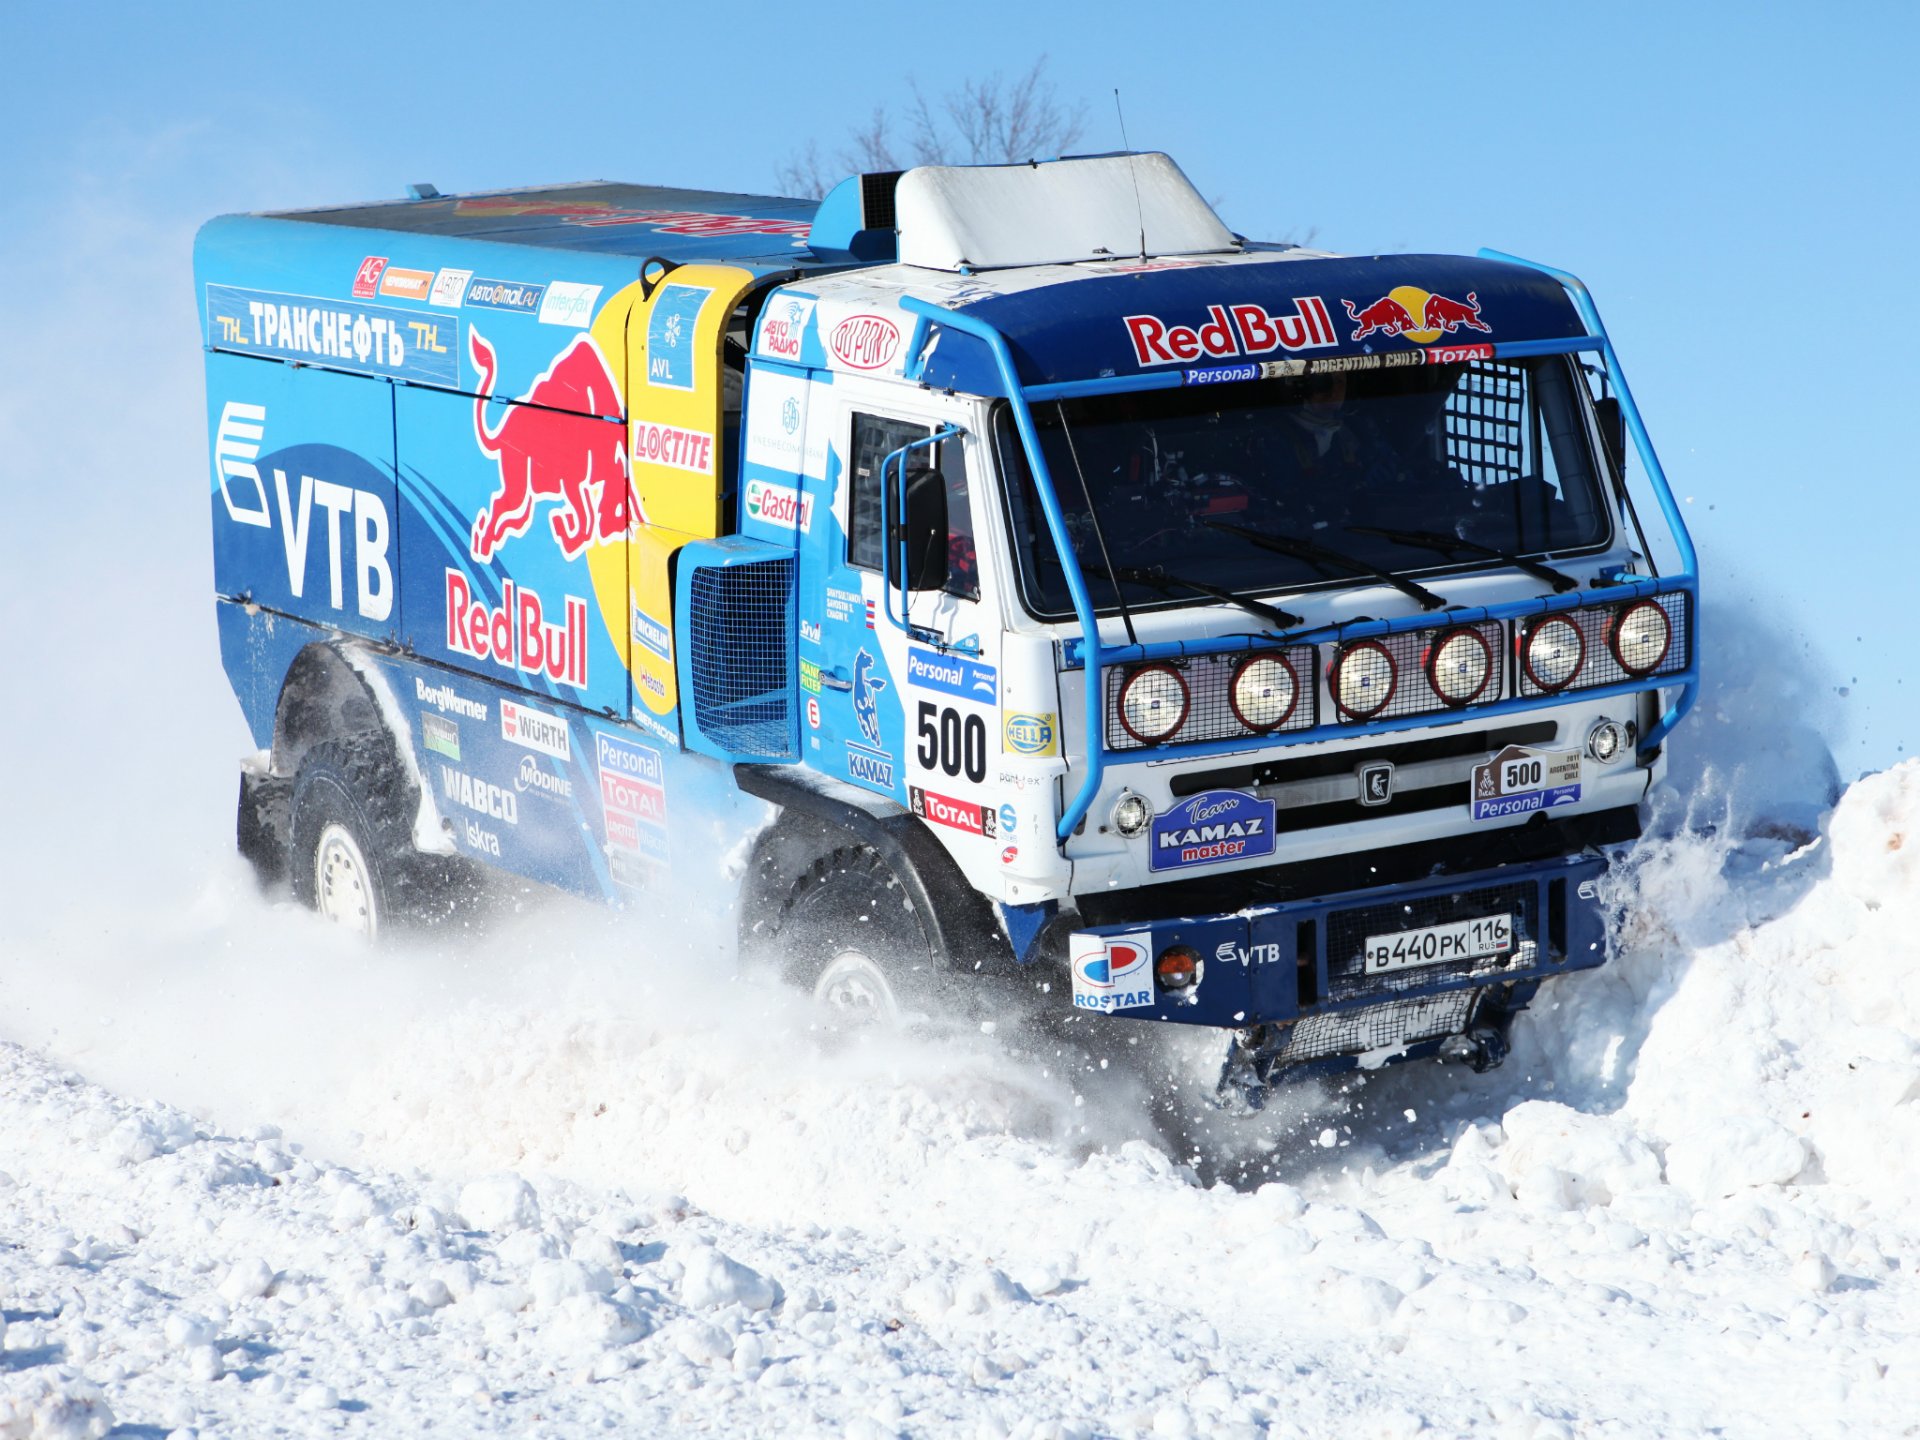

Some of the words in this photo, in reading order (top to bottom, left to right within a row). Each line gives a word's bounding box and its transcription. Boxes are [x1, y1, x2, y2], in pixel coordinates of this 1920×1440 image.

[357, 259, 384, 284] AG
[249, 301, 405, 367] ТРАНСНЕФТЬ
[768, 337, 799, 356] РАДИО
[1123, 304, 1241, 367] Red
[1230, 296, 1339, 355] Bull
[651, 358, 673, 380] AVL
[1188, 364, 1256, 384] Personal
[1310, 356, 1380, 374] ARGENTINA
[1385, 352, 1419, 367] CHILE
[1430, 349, 1491, 363] TOTAL
[636, 424, 711, 470] LOCTITE
[761, 488, 810, 527] Castrol
[273, 468, 395, 623] VTB
[446, 566, 516, 669] Red
[516, 588, 588, 690] Bull
[637, 617, 668, 650] MICHELIN
[908, 655, 963, 687] Personal
[972, 669, 996, 683] Personal
[415, 677, 488, 722] BorgWarner
[917, 700, 987, 784] 500
[1008, 725, 1052, 744] HELLA
[601, 738, 658, 779] Personal
[847, 752, 895, 790] KAMAZ
[1549, 763, 1579, 774] ARGENTINA
[1506, 761, 1542, 788] 500
[1564, 772, 1579, 781] CHILE
[441, 764, 519, 825] WABCO
[603, 775, 664, 819] TOTAL
[1479, 791, 1545, 818] Personal
[1553, 786, 1576, 796] Personal
[925, 795, 982, 830] TOTAL
[1185, 796, 1240, 825] Team
[465, 817, 501, 858] Iskra
[1160, 818, 1264, 849] KAMAZ
[1181, 840, 1245, 862] master
[1472, 919, 1505, 943] 116
[1238, 943, 1280, 967] VTB
[1478, 942, 1496, 951] RUS
[1074, 990, 1151, 1009] ROSTAR
